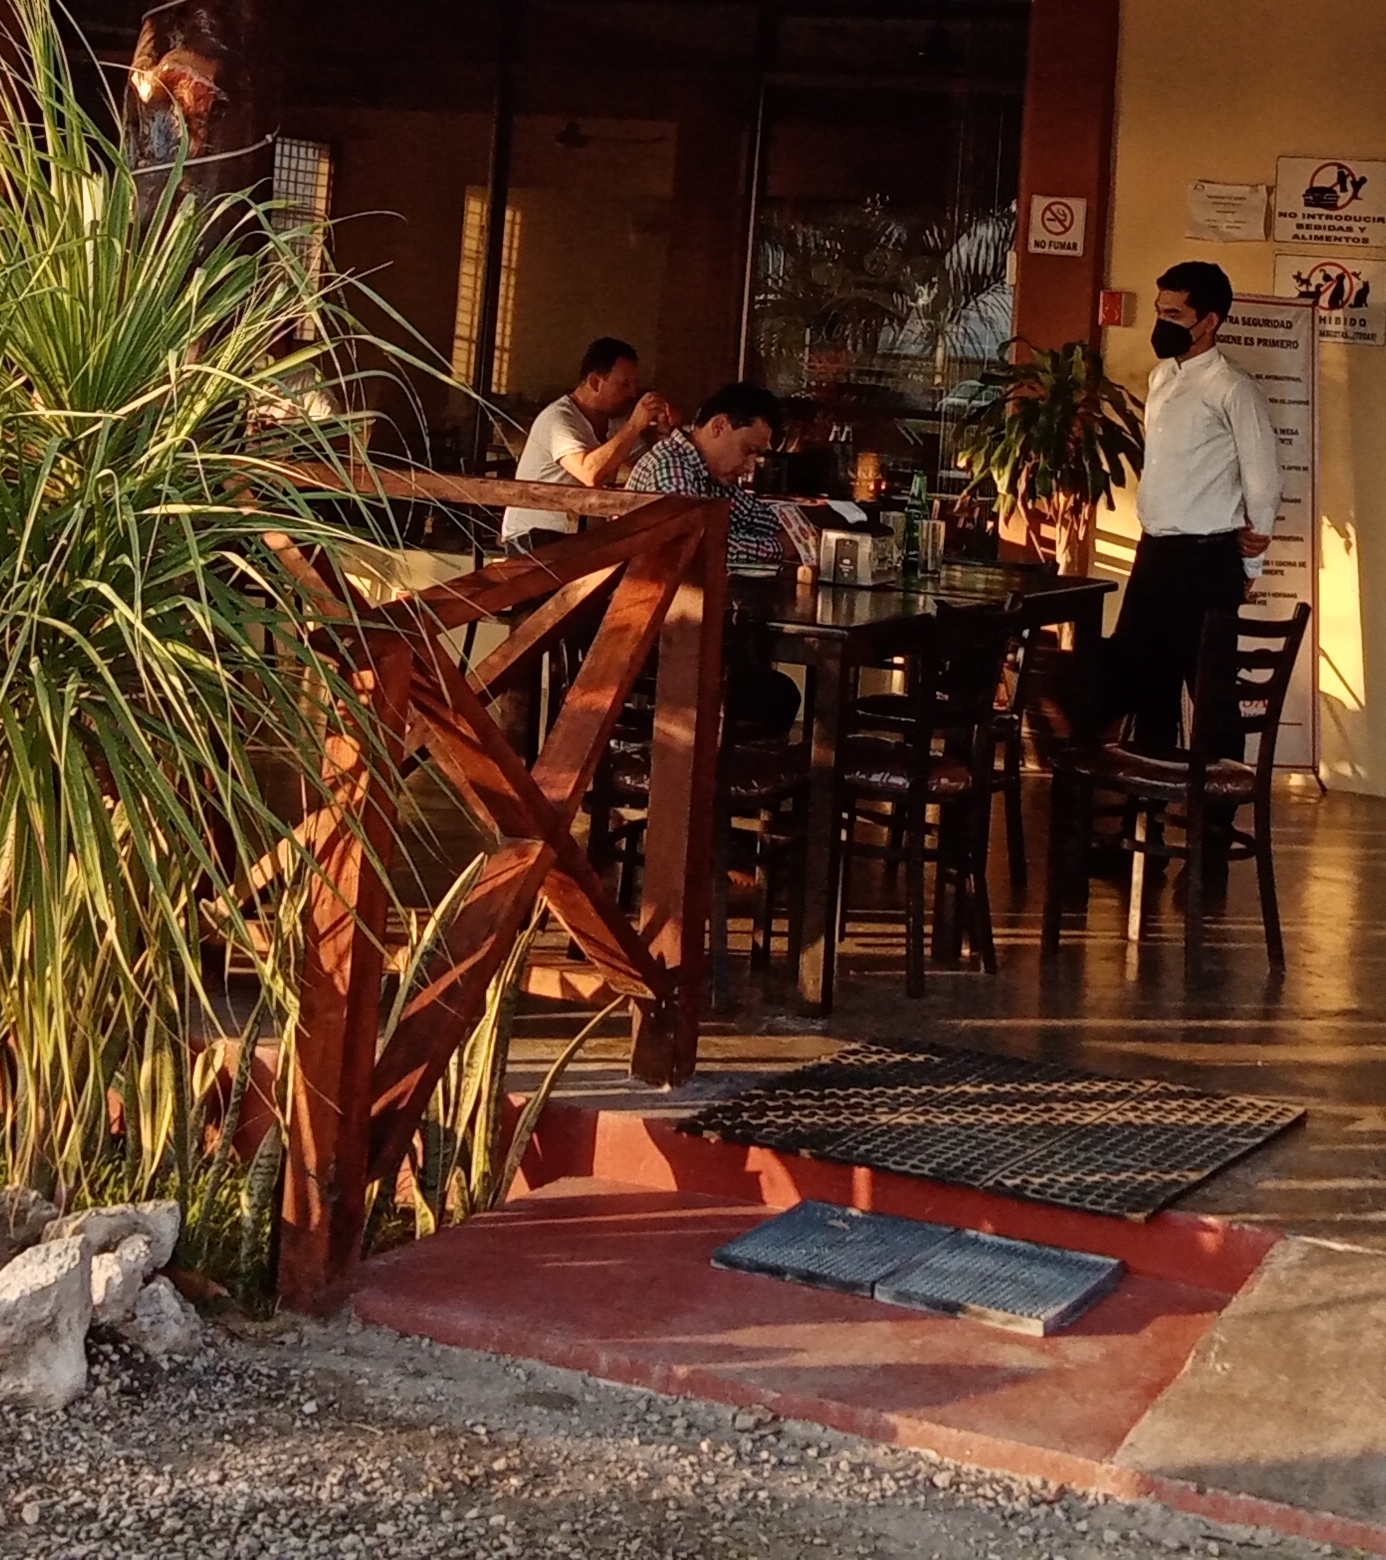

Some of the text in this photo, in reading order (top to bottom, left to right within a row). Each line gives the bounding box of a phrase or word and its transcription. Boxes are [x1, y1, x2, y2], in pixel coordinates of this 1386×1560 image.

[1278, 211, 1386, 224] NO INTRODUCIR
[1295, 223, 1354, 233] BEBIDAS
[1291, 233, 1370, 244] ALIMENTOS
[1033, 239, 1078, 251] NO FUMAR
[1241, 316, 1293, 329] SEGURIDAD
[1318, 315, 1367, 327] HIBIDO
[1244, 336, 1255, 346] ES
[1256, 338, 1300, 350] PRIMERO
